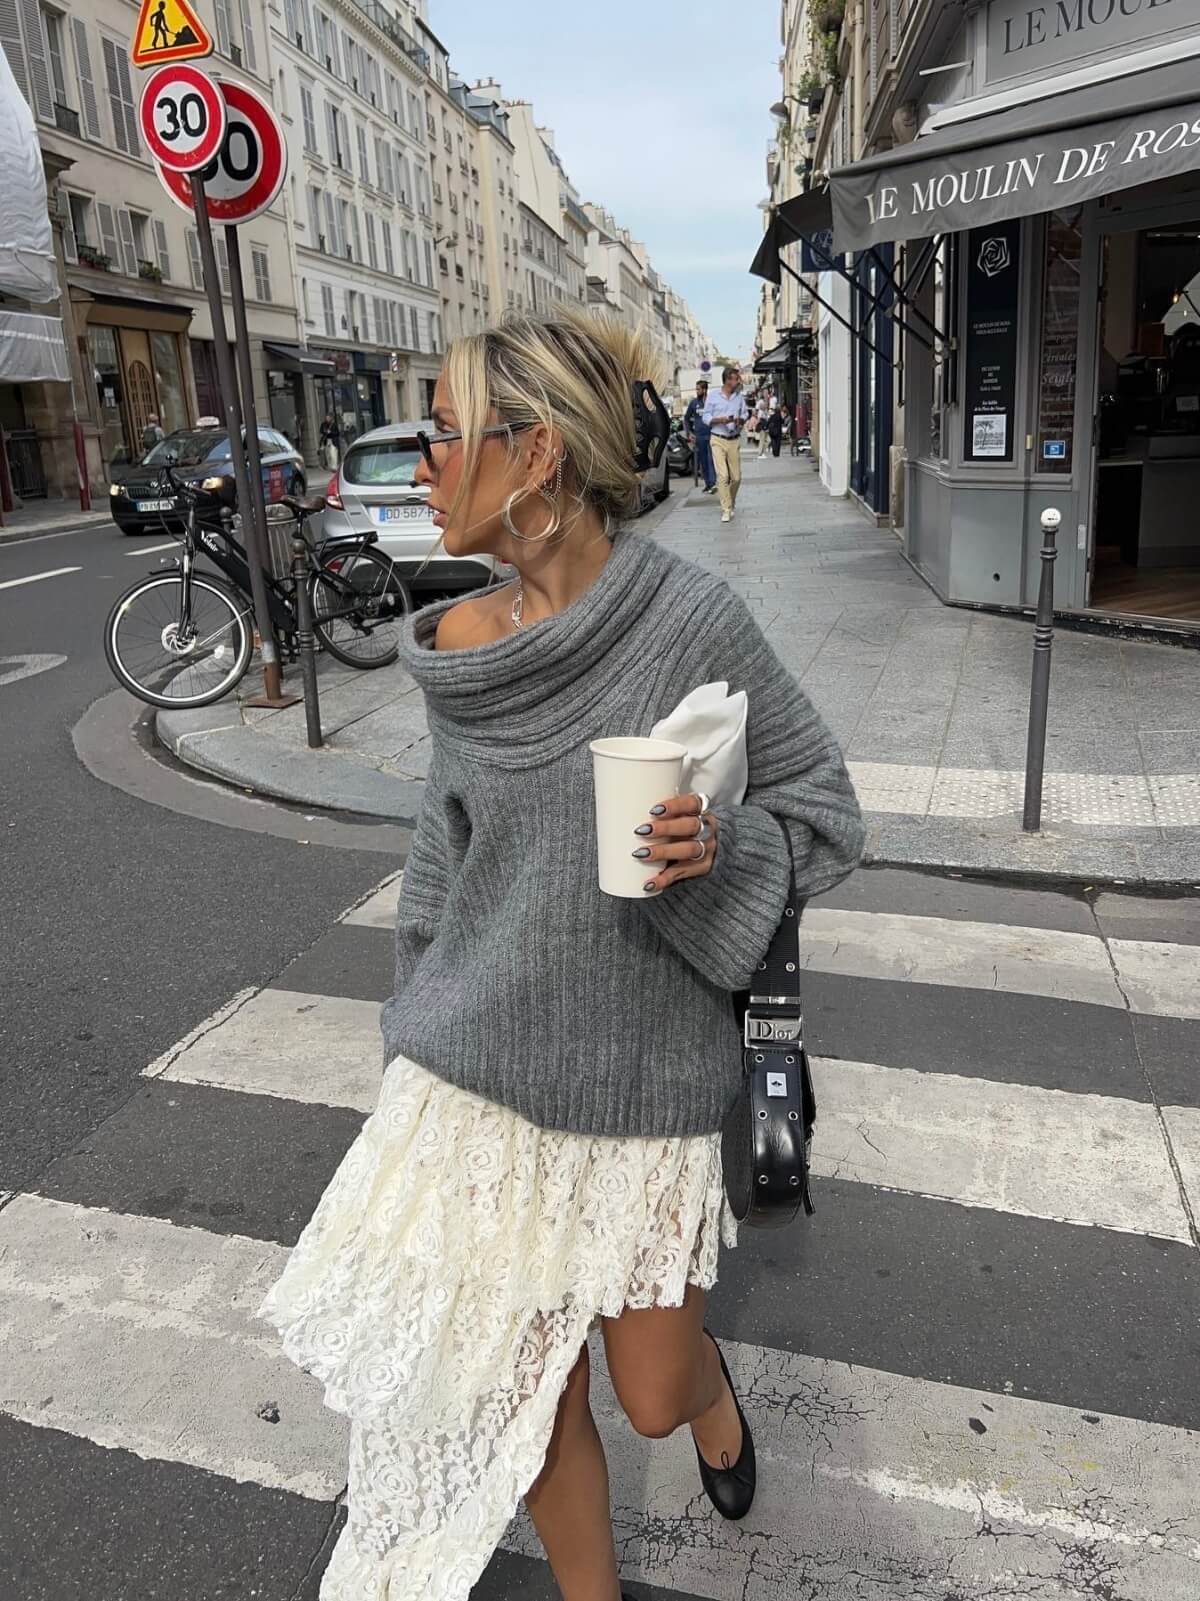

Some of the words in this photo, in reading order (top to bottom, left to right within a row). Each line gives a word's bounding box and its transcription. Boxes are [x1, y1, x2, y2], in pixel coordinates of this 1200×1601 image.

[1004, 7, 1048, 54] LE
[1054, 0, 1171, 39] MO
[155, 92, 208, 142] 30
[201, 120, 259, 182] 0
[911, 153, 1045, 216] MOULIN
[1054, 140, 1116, 185] DE
[1119, 118, 1200, 165] ROS
[757, 1021, 794, 1041] Dior
